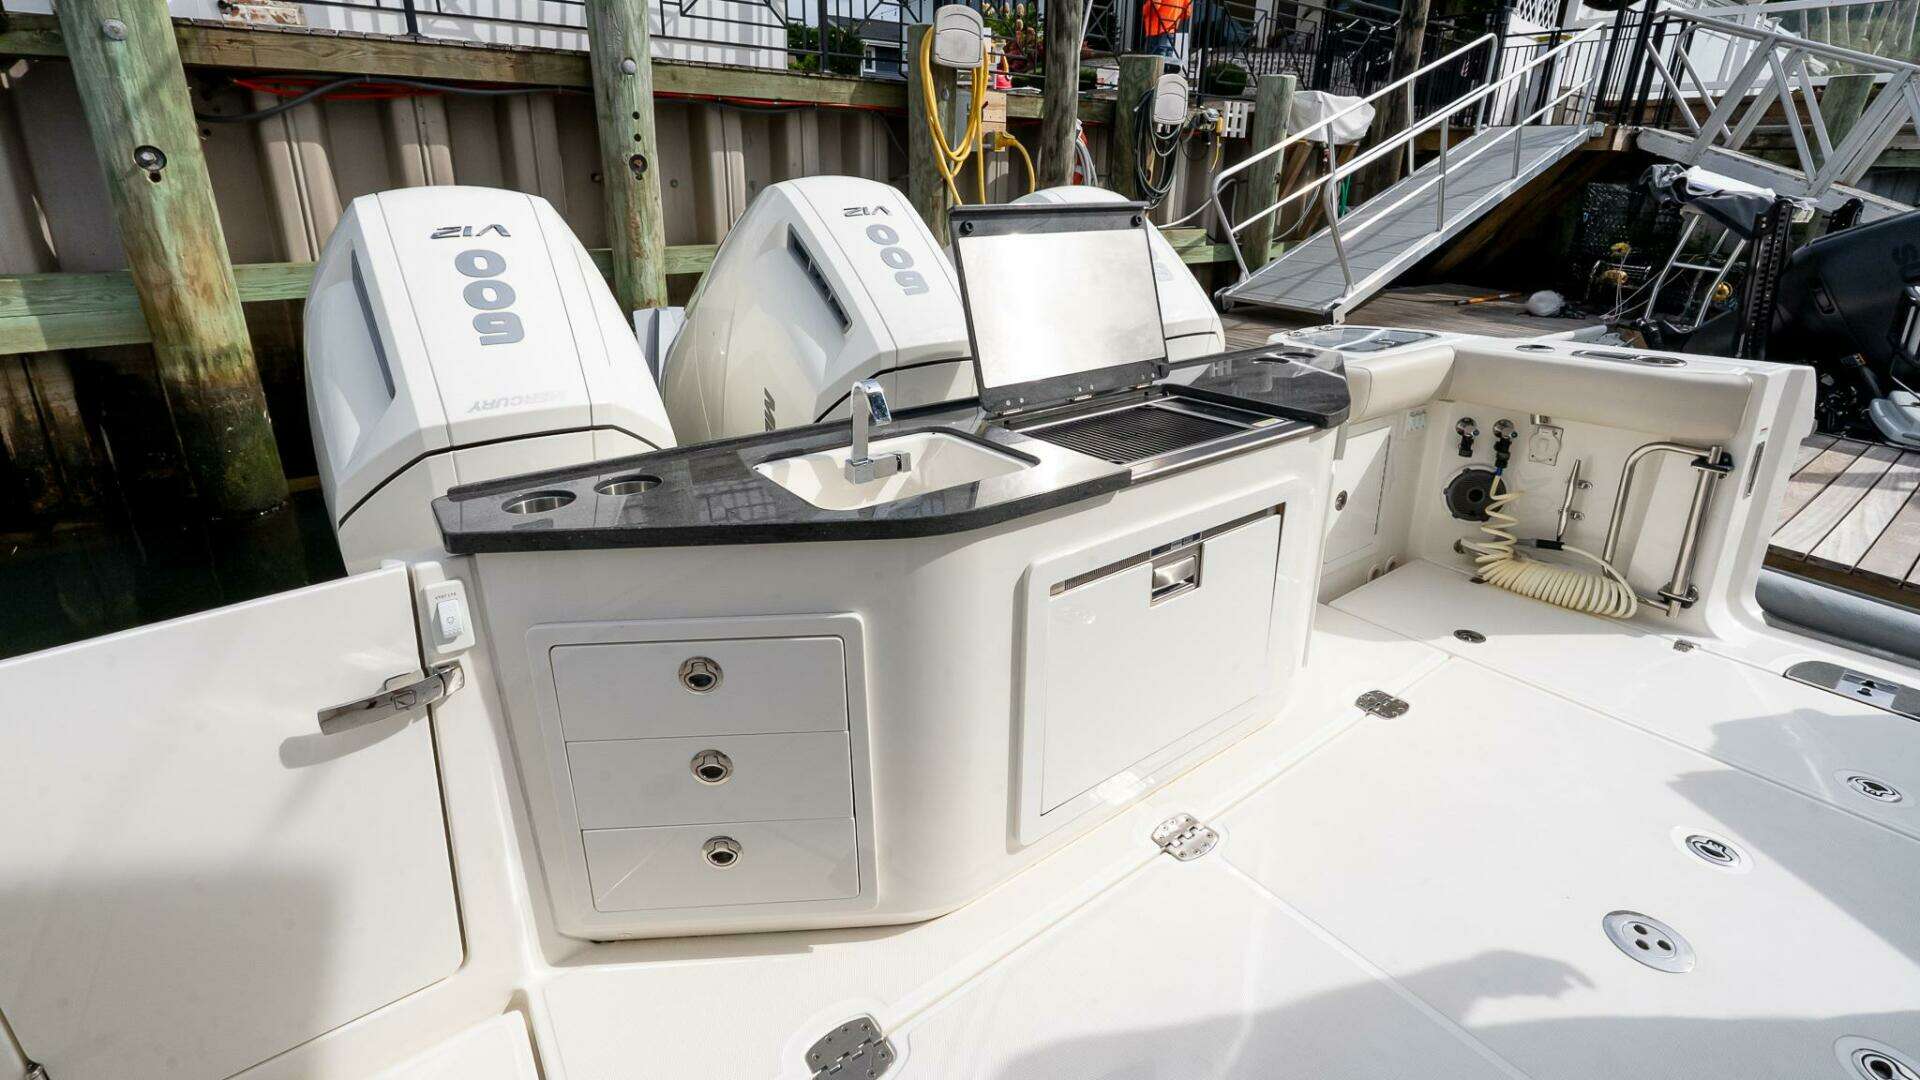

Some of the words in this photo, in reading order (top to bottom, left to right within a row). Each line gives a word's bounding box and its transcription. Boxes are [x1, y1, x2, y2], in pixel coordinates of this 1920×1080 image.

[430, 224, 511, 239] V12
[843, 206, 890, 218] V12
[866, 224, 929, 296] 600
[454, 249, 525, 346] 600
